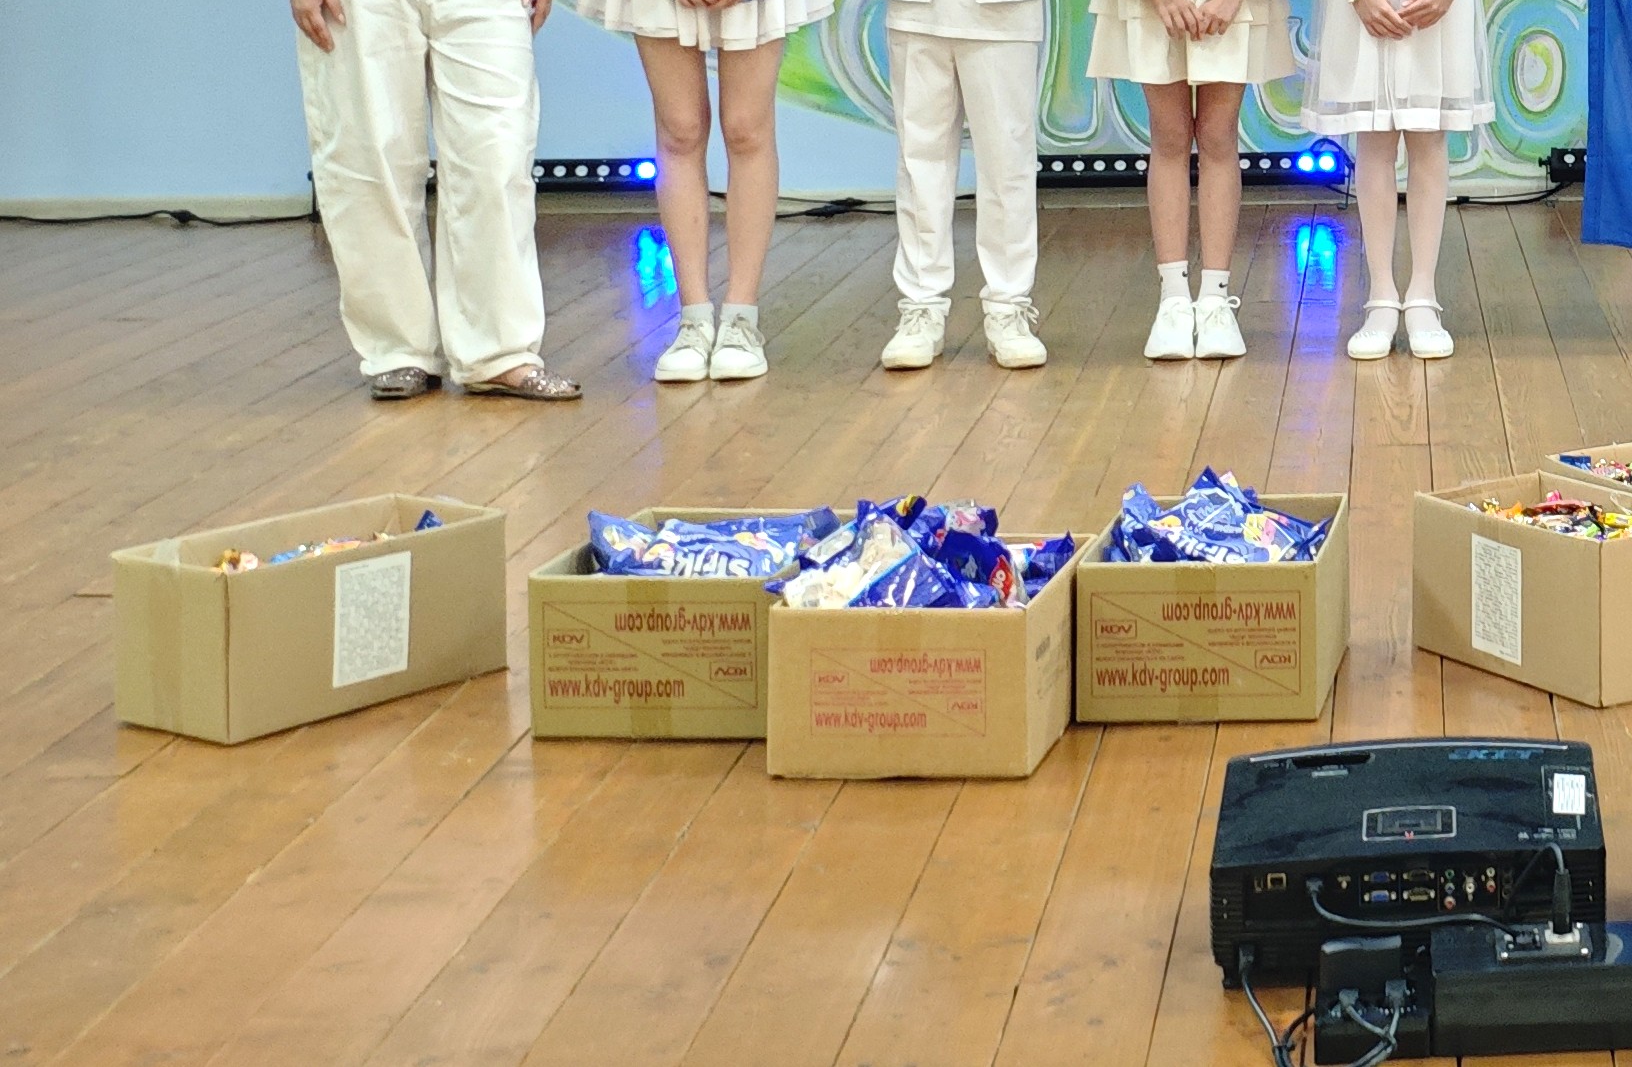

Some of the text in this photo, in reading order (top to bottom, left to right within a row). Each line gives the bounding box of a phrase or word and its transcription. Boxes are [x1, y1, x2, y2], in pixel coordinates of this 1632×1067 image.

[614, 606, 752, 637] www.kdv-group.com
[1161, 596, 1297, 626] www.kdv-group.com
[549, 673, 685, 704] www.kdv-group.com
[1095, 661, 1230, 693] www.kdv-group.com
[814, 707, 928, 734] www.kdv-group.com
